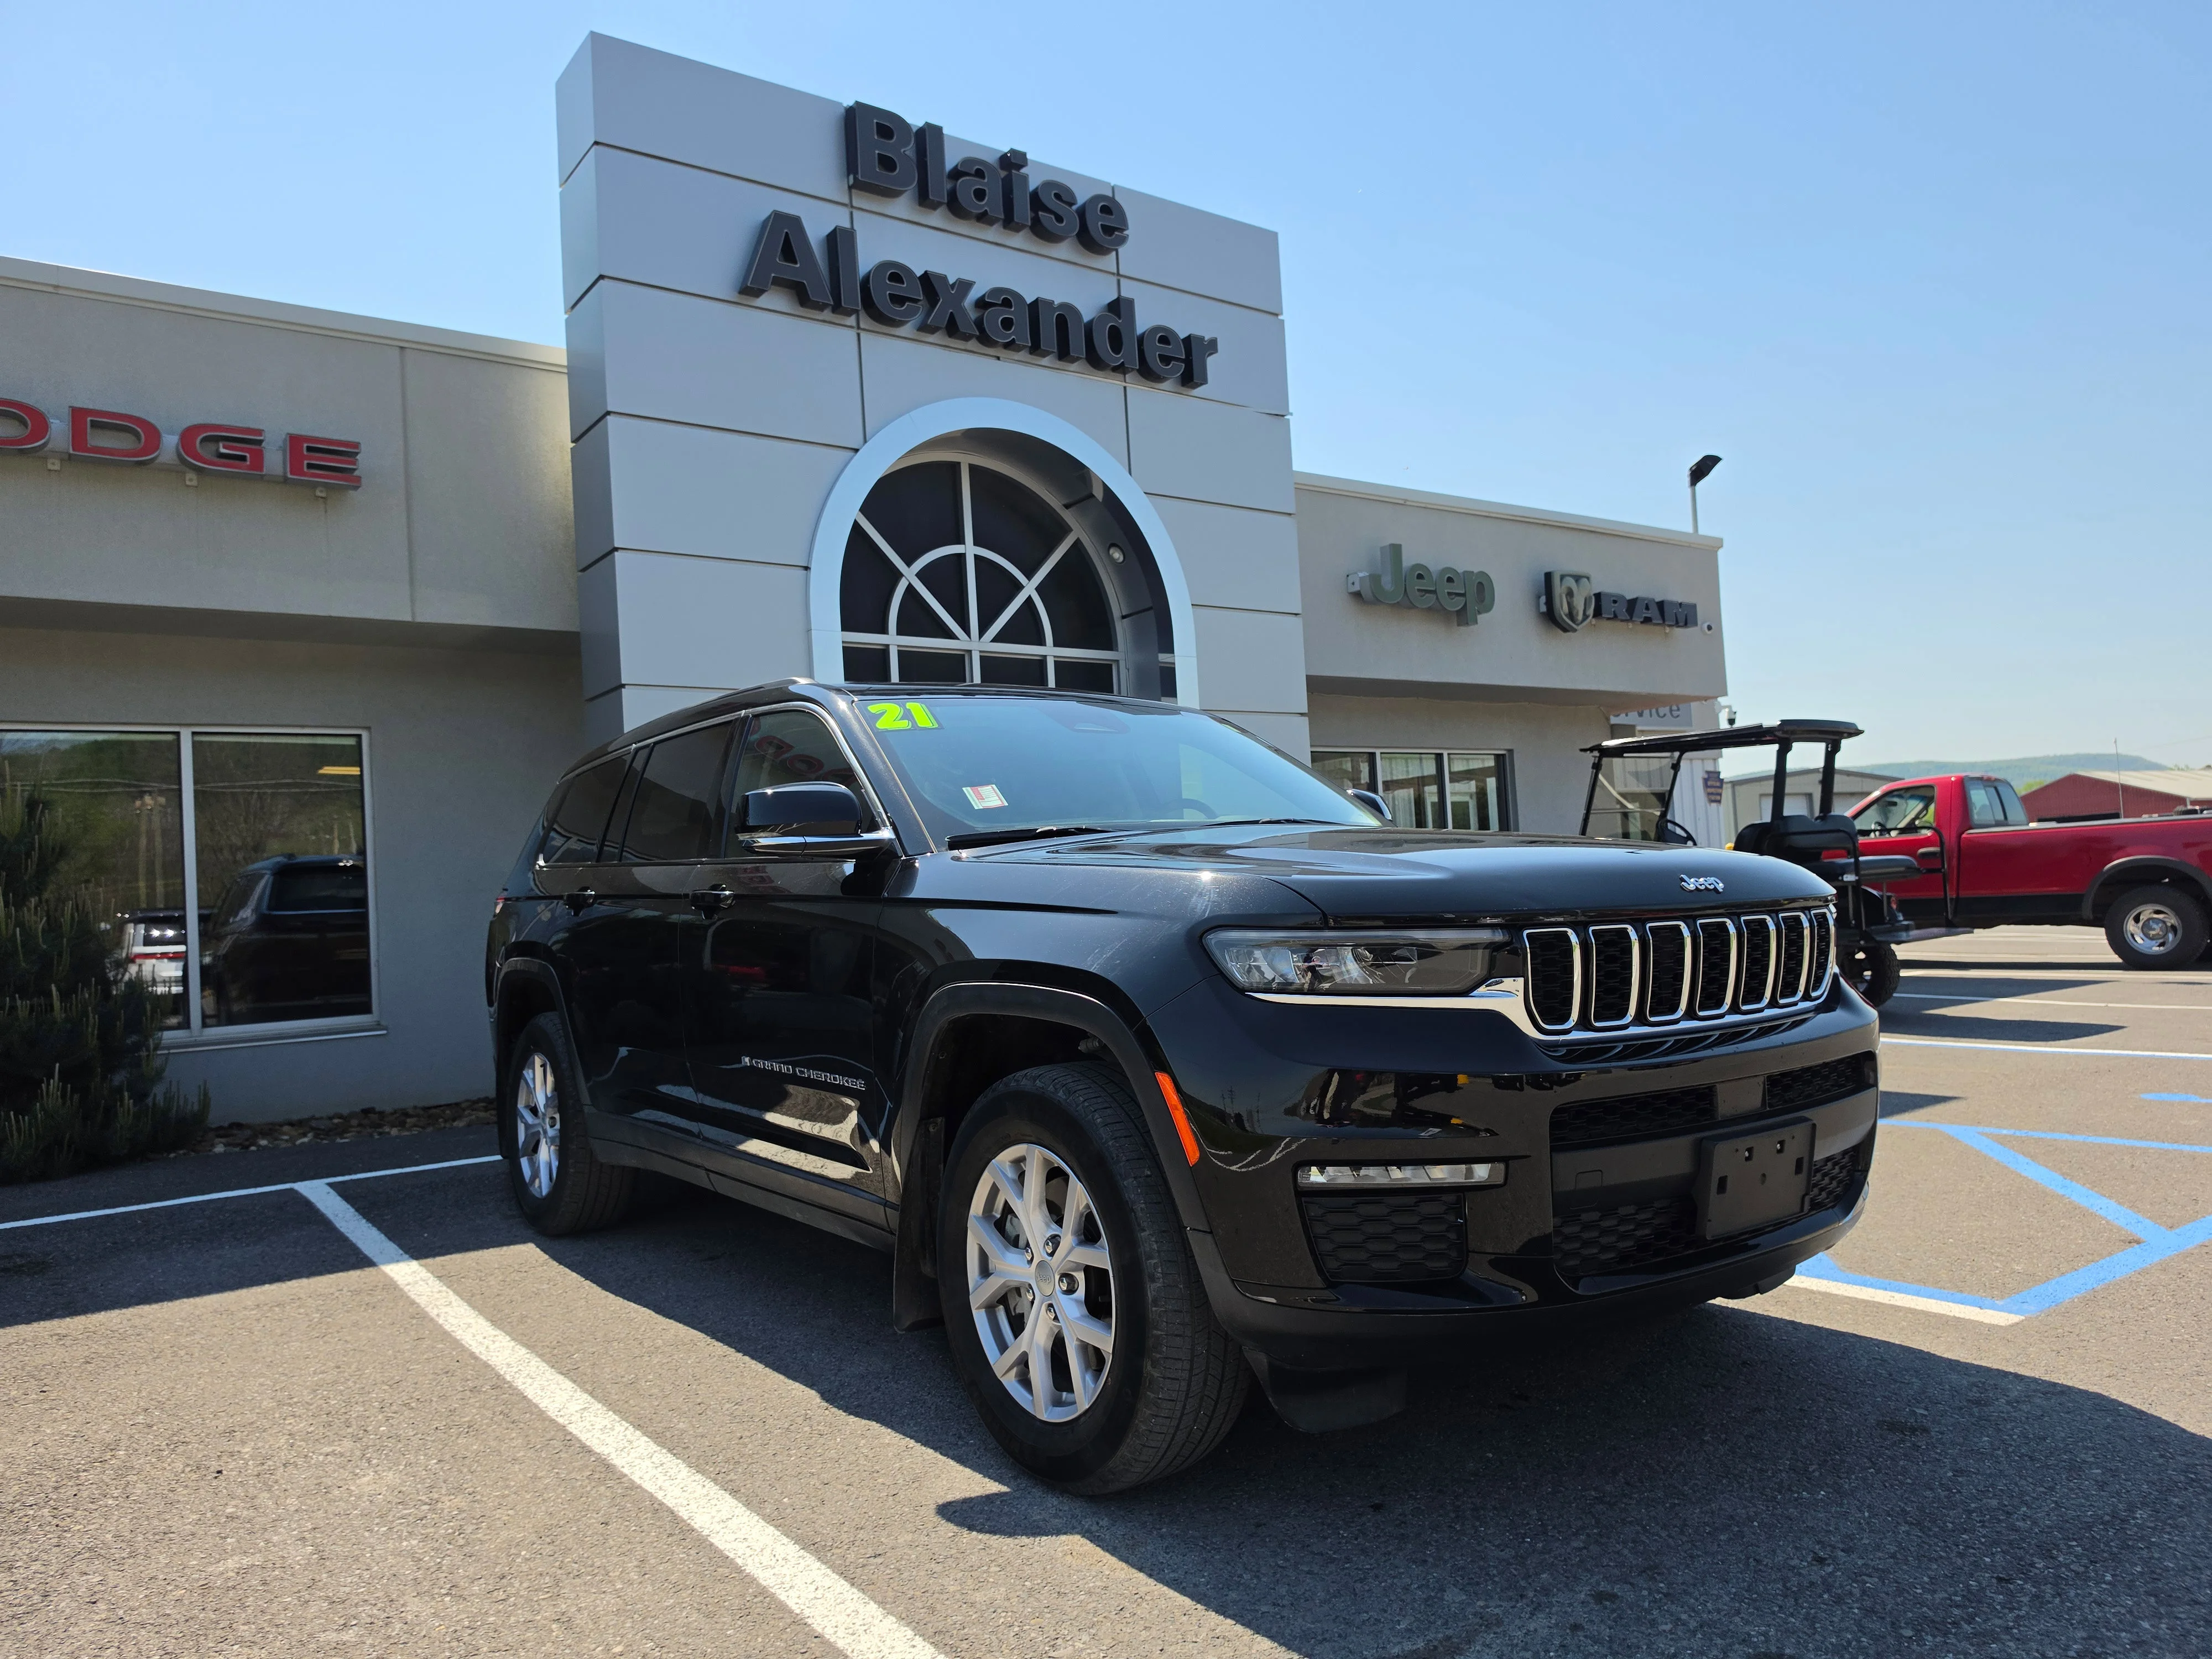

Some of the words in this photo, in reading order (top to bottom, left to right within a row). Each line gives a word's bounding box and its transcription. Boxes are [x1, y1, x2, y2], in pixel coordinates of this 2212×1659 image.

[845, 101, 1129, 255] Blaise
[739, 210, 1218, 389] Alexander
[1359, 544, 1495, 627] Jeep
[1592, 591, 1698, 629] RAM
[868, 702, 938, 730] 21
[1679, 874, 1724, 894] Jeep
[753, 1058, 792, 1074] GRAND
[795, 1067, 865, 1090] CHEROKEE
[1036, 1272, 1052, 1284] Jeep
